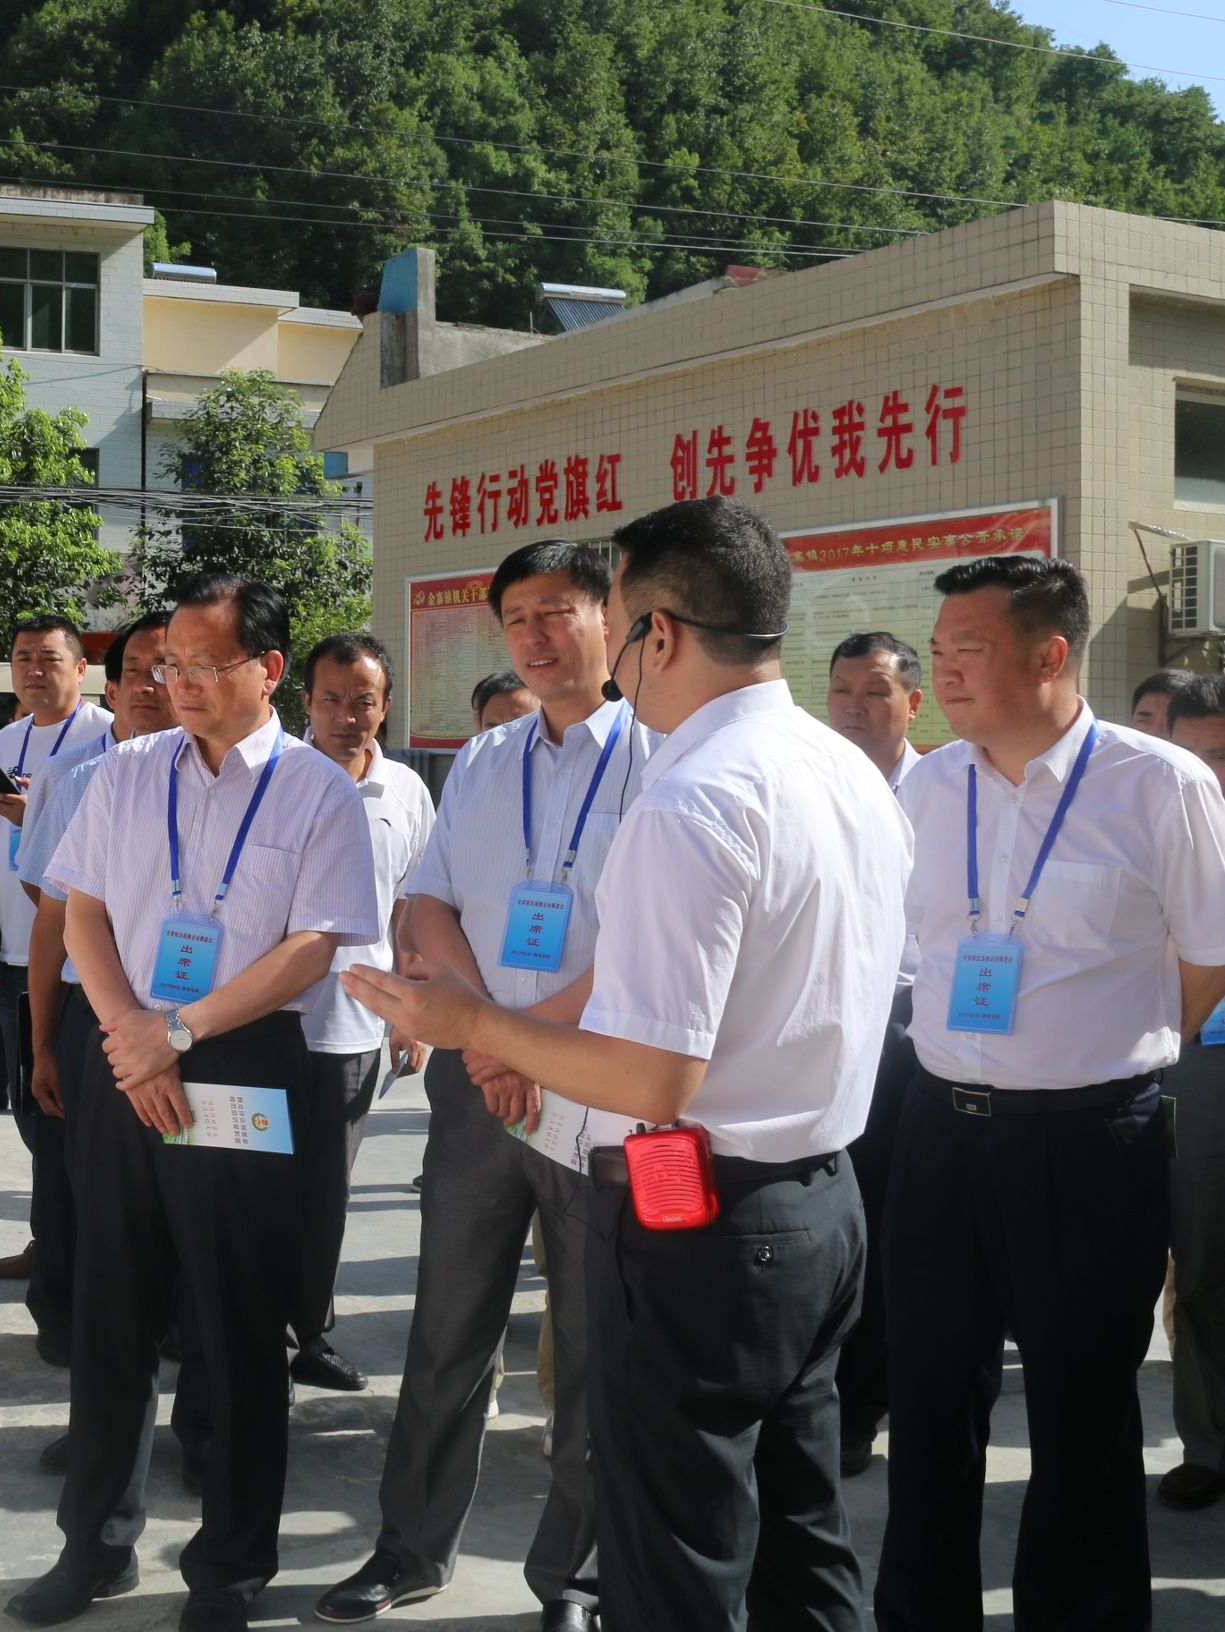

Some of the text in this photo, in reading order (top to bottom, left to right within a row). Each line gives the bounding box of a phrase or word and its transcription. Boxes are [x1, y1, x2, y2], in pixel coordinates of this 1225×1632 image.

[423, 384, 967, 542] 先锋行动党旗红 创先争优我先行
